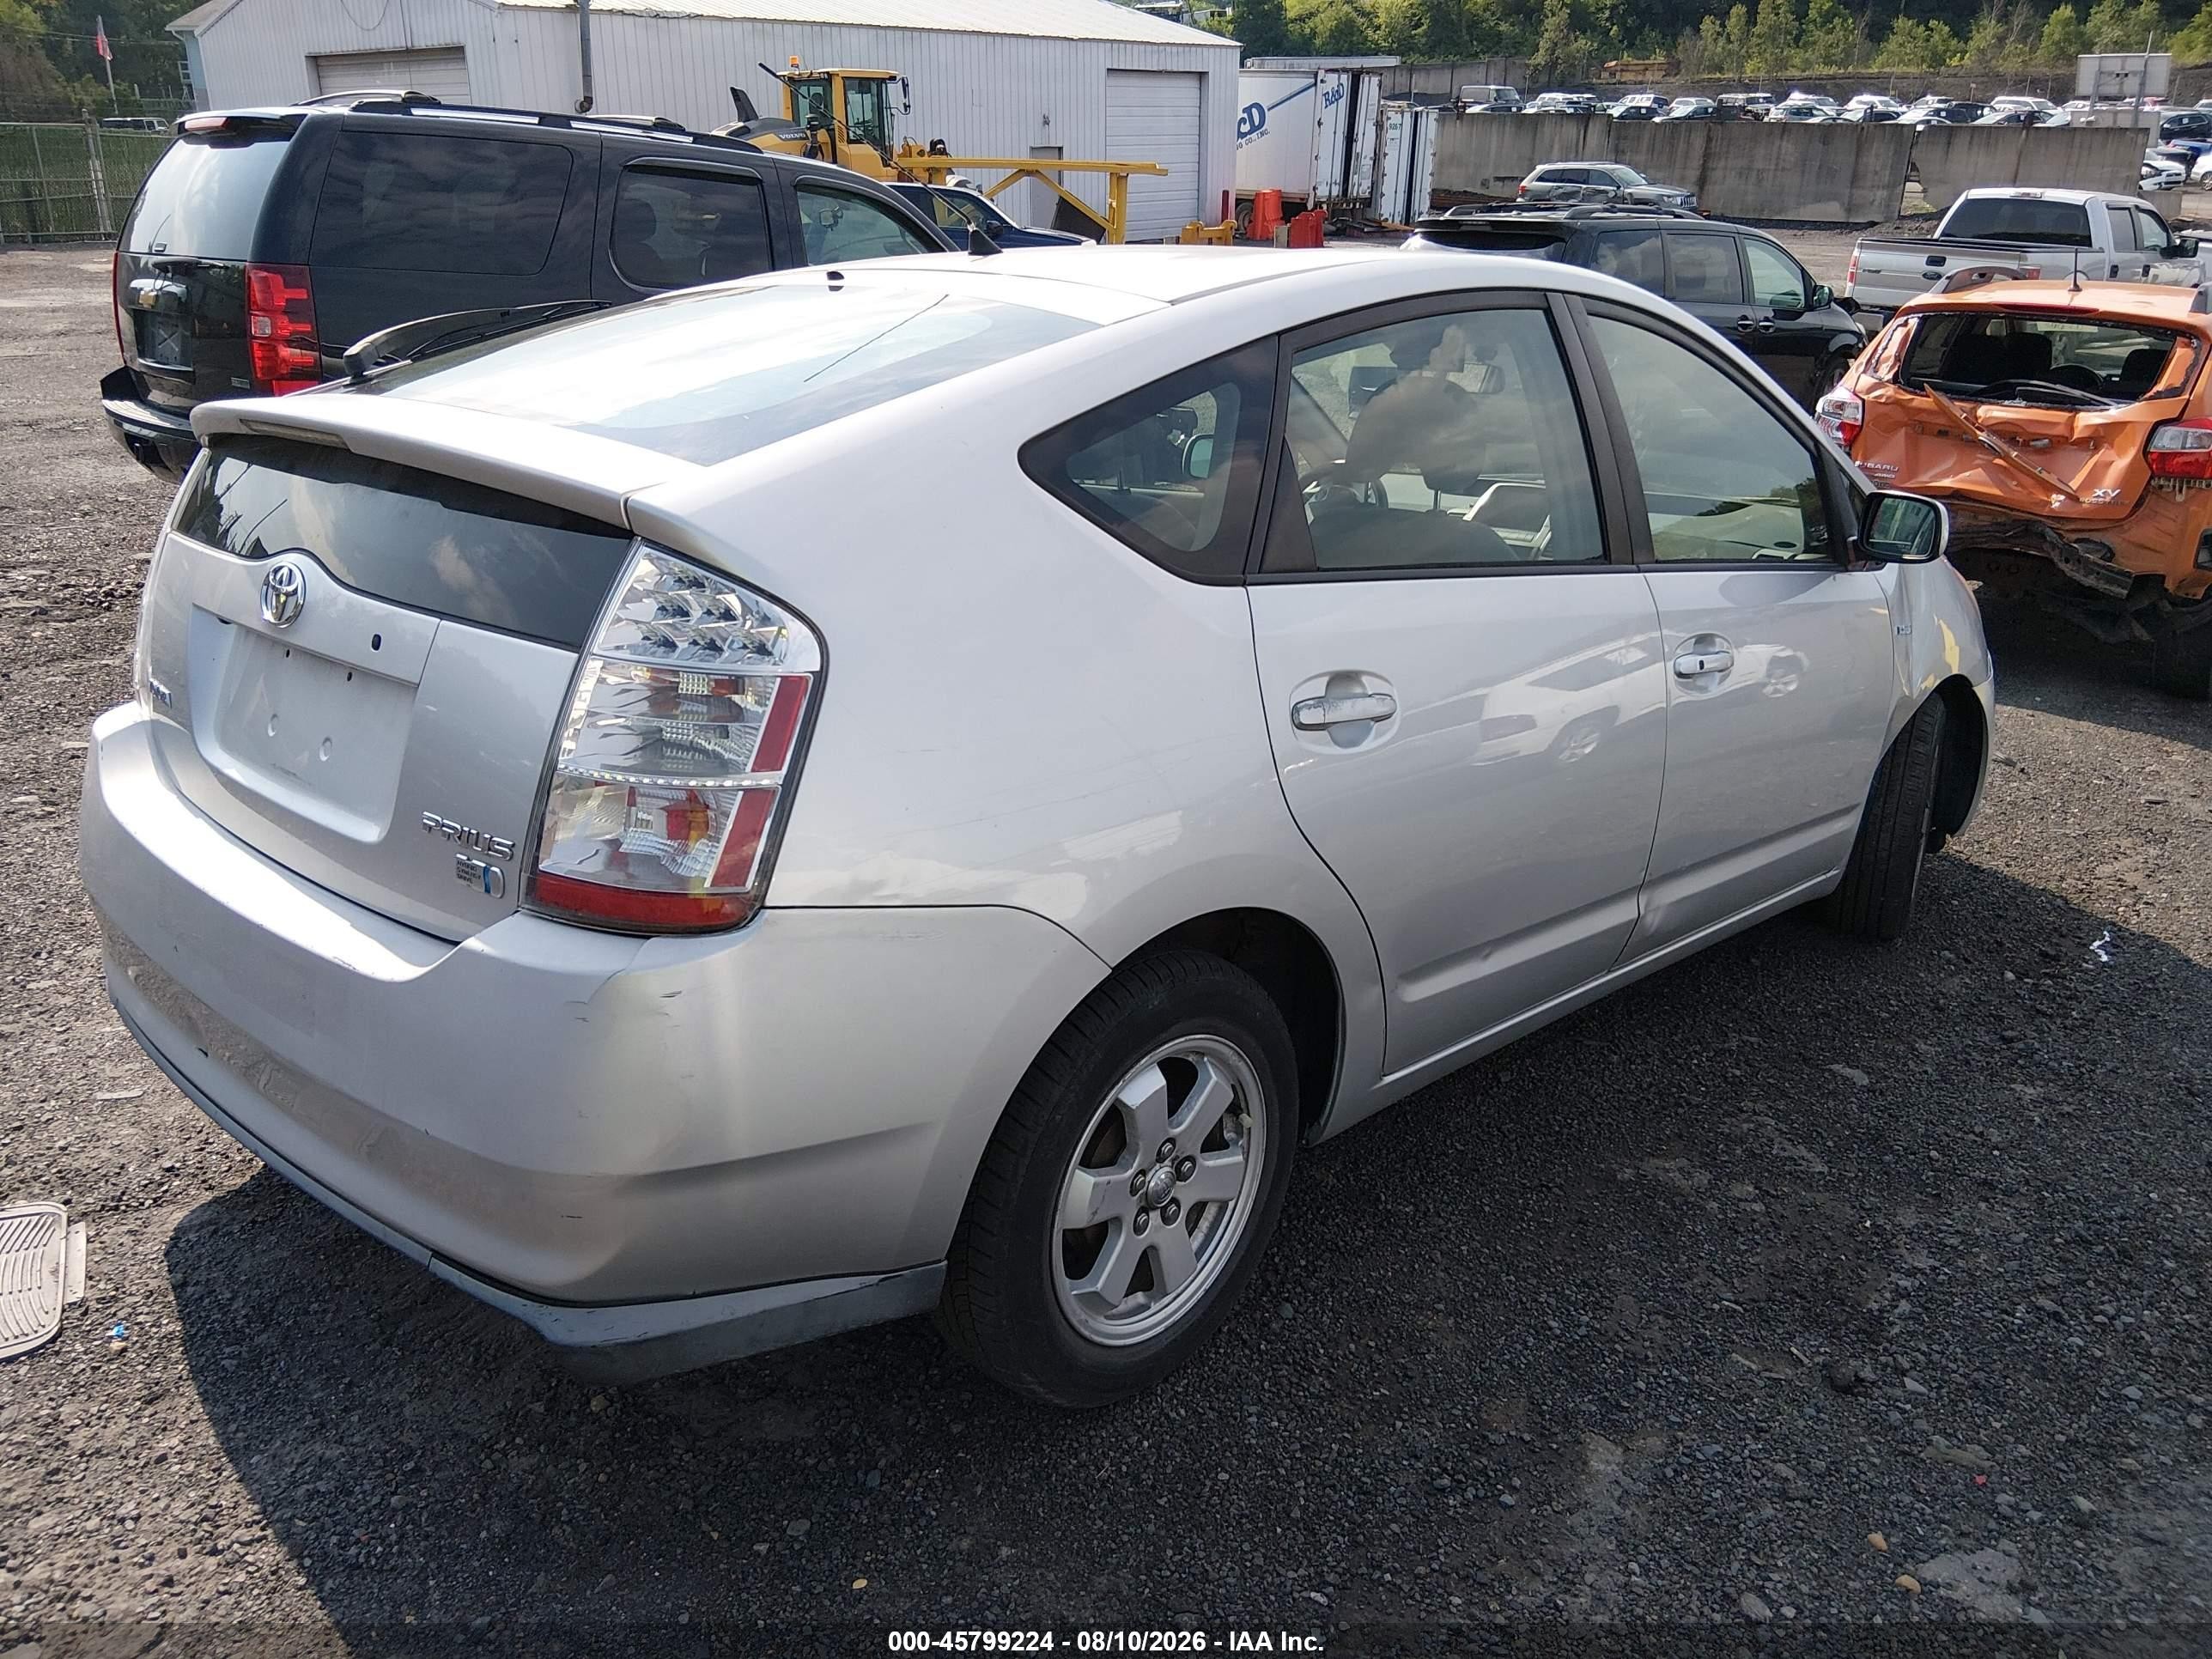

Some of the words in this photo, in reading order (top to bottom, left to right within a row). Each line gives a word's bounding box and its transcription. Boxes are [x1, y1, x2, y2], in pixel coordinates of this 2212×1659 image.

[1322, 82, 1345, 110] R&D
[2092, 489, 2121, 497] XV
[422, 811, 515, 862] PRIUS
